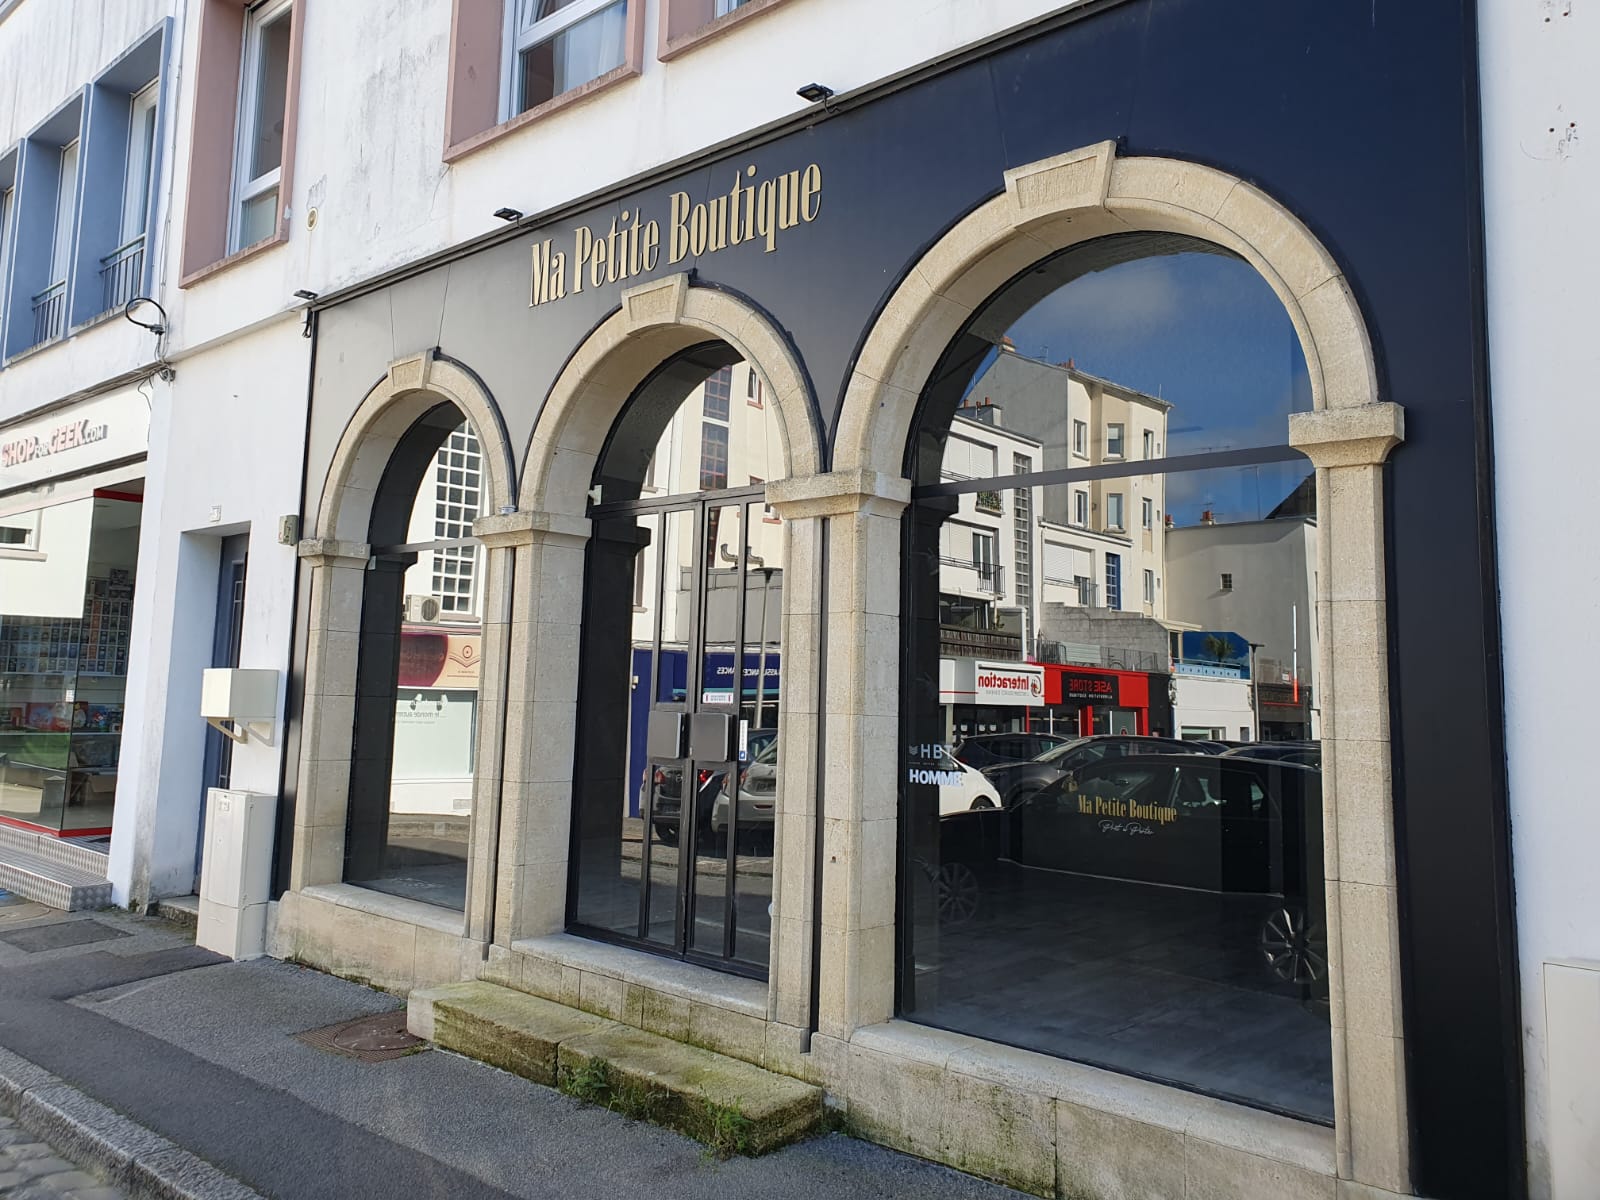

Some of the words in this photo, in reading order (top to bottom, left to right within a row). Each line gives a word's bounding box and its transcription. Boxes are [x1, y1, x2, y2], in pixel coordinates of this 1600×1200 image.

[529, 238, 568, 308] Ma
[572, 207, 661, 294] Petite
[667, 163, 822, 265] Boutique
[1078, 794, 1093, 814] Ma
[1095, 796, 1127, 817] Petite
[1129, 798, 1178, 826] Boutique
